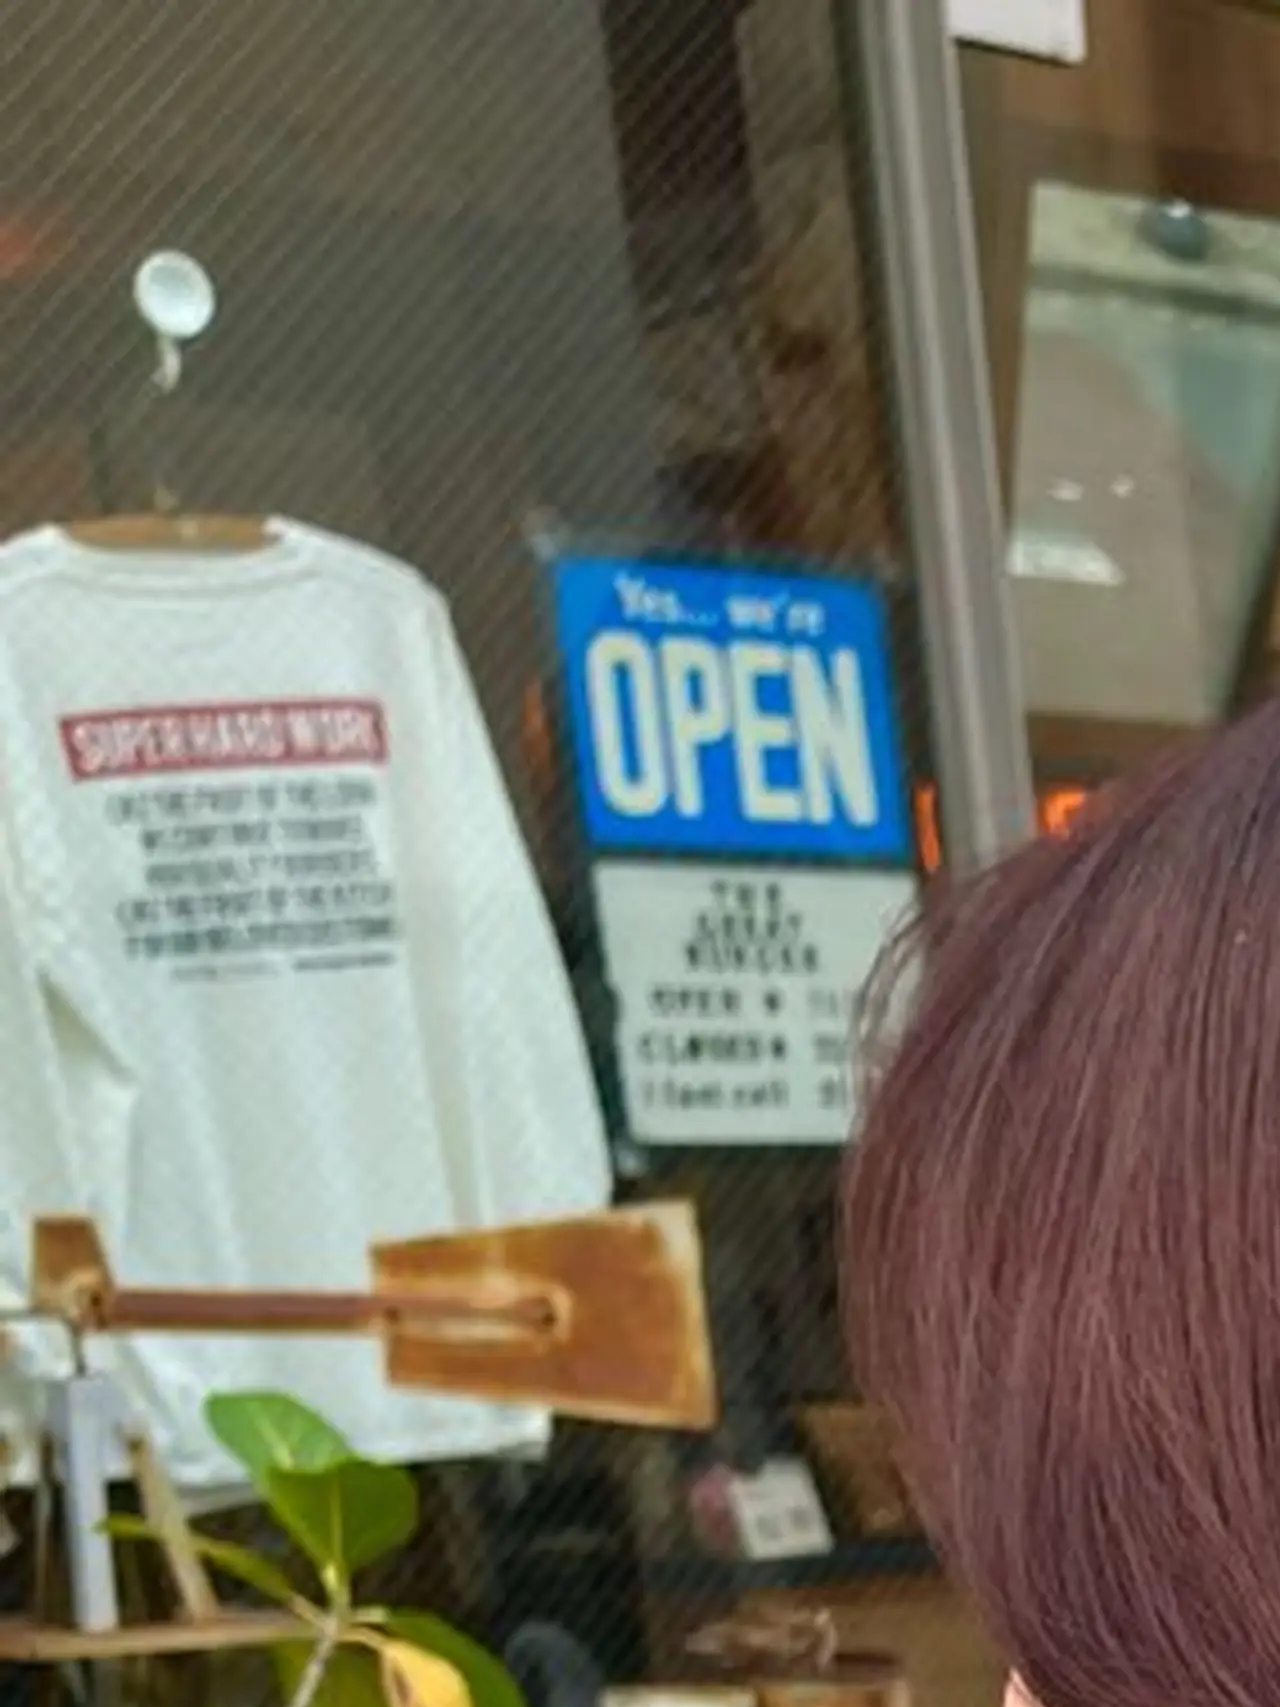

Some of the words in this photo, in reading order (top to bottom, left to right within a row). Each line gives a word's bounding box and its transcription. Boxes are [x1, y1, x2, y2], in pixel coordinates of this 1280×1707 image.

[72, 713, 190, 773] SUPER
[191, 709, 286, 760] HARD
[288, 704, 380, 757] WORK
[584, 628, 880, 828] OPEN
